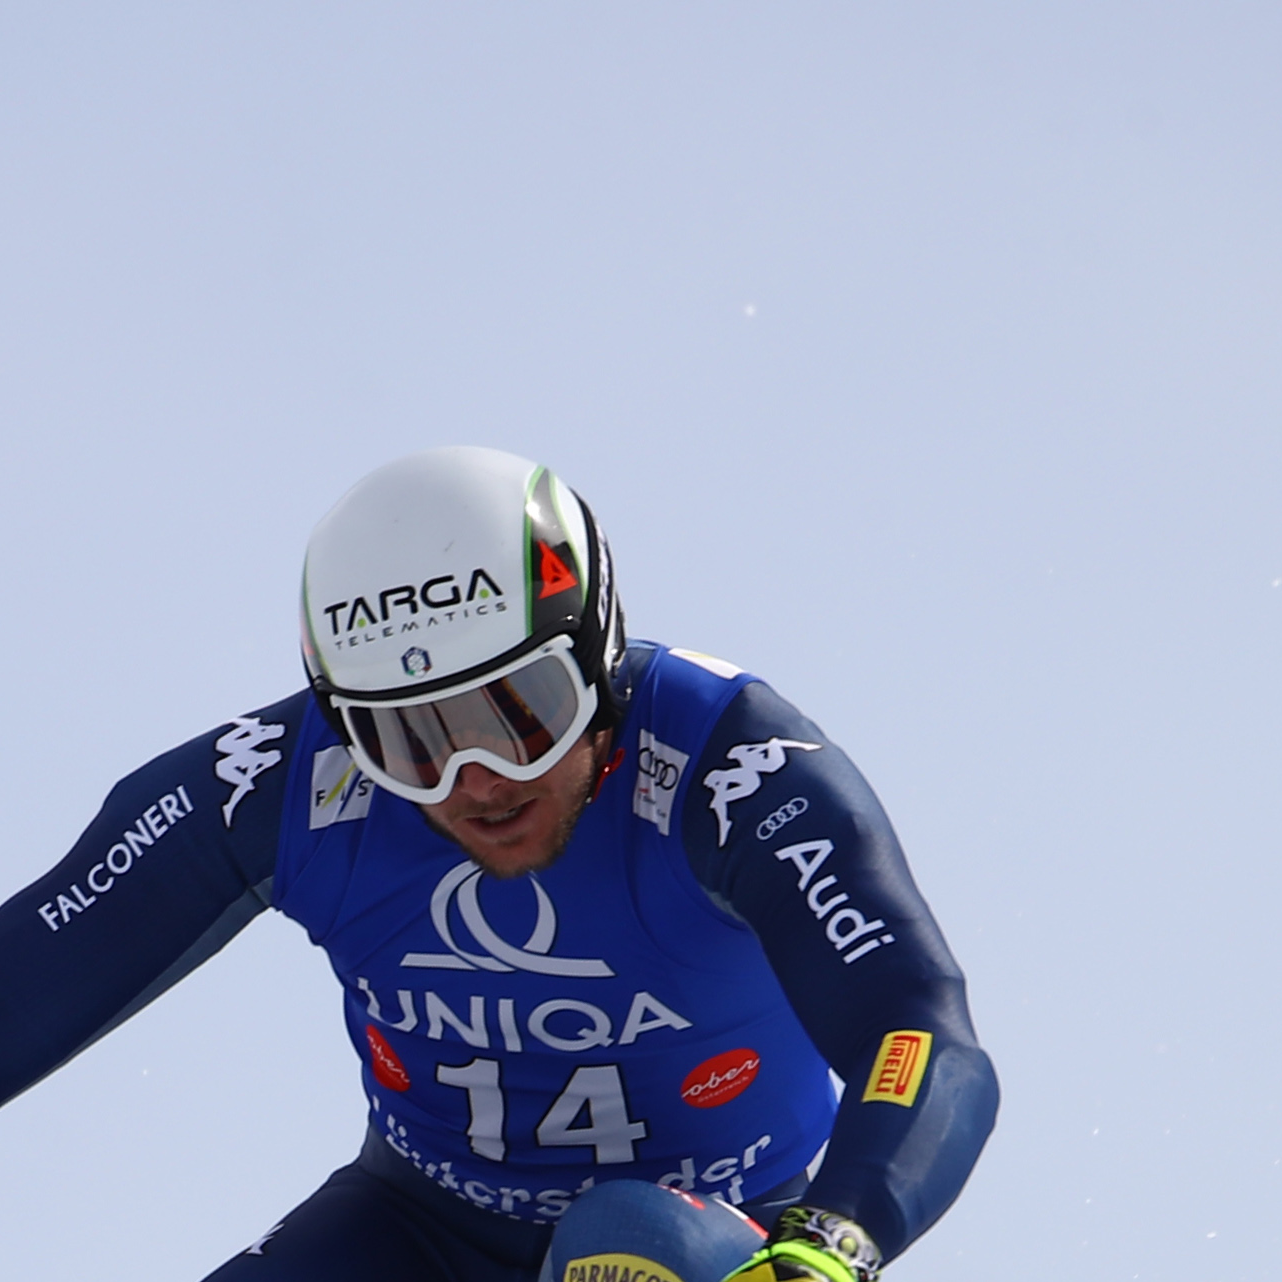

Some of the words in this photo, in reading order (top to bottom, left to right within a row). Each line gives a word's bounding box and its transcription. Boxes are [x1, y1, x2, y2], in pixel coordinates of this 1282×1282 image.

[324, 568, 503, 635] TARGA
[335, 601, 507, 650] TELEMATICS
[37, 785, 195, 932] FALCONERI
[774, 839, 896, 965] Audi
[357, 975, 693, 1052] UNIQA
[681, 1057, 761, 1098] ober
[874, 1034, 921, 1096] PIRELLI
[436, 1057, 647, 1165] 14
